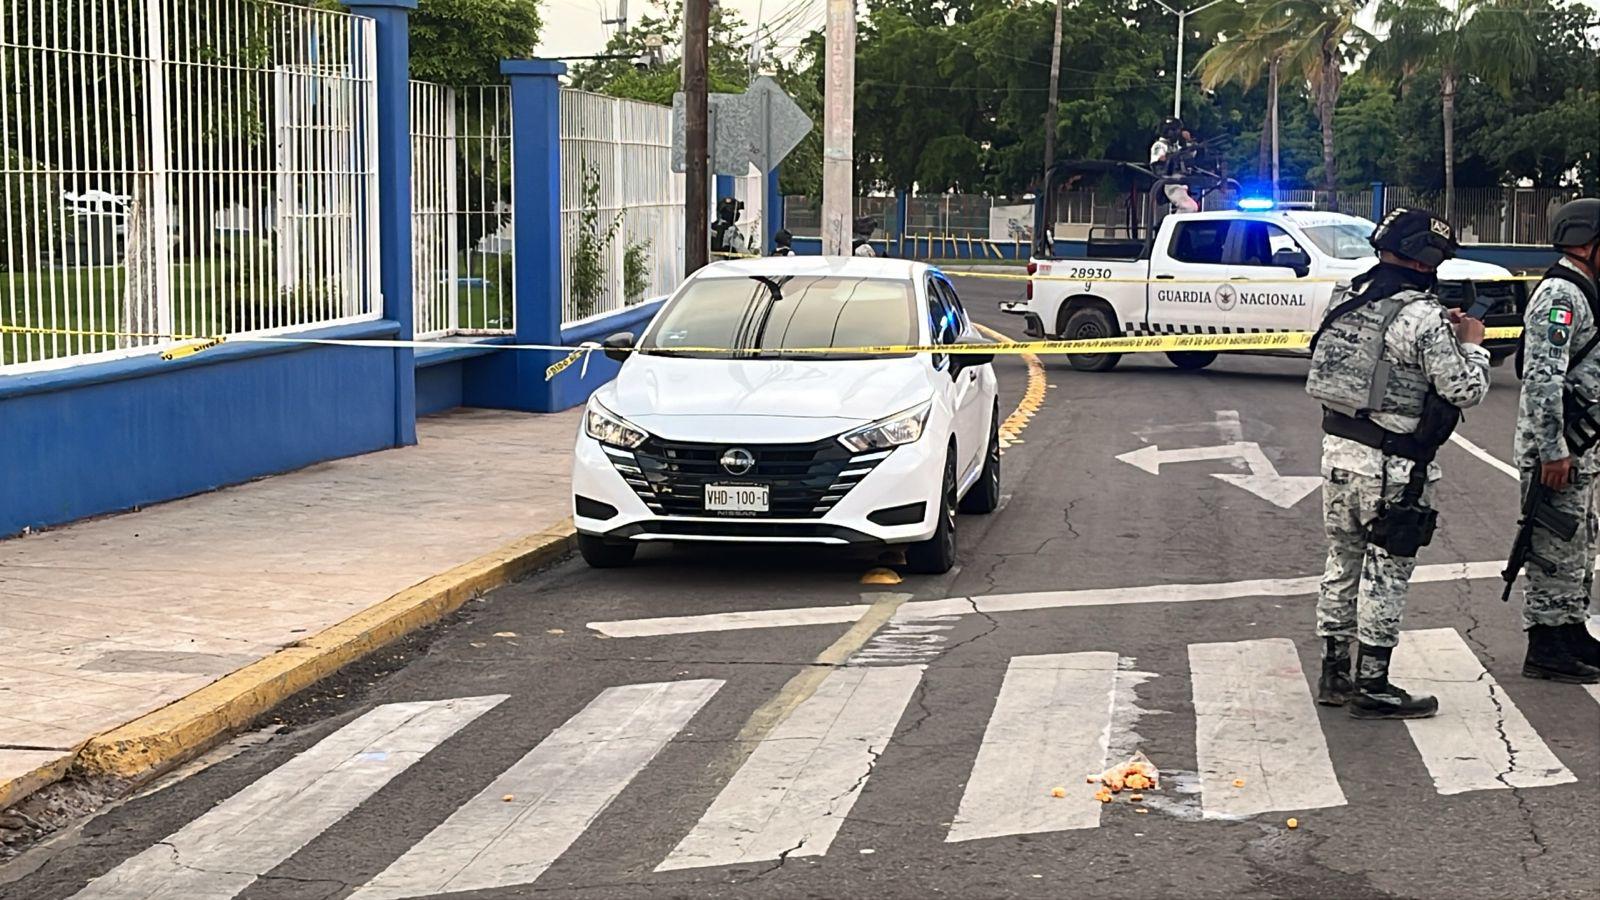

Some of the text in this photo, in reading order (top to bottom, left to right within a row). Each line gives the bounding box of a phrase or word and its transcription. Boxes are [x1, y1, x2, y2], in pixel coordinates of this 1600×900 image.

[1070, 267, 1112, 279] 28930
[1158, 290, 1306, 306] GUARDIA NACIONAL
[707, 490, 768, 506] VHD-100-D
